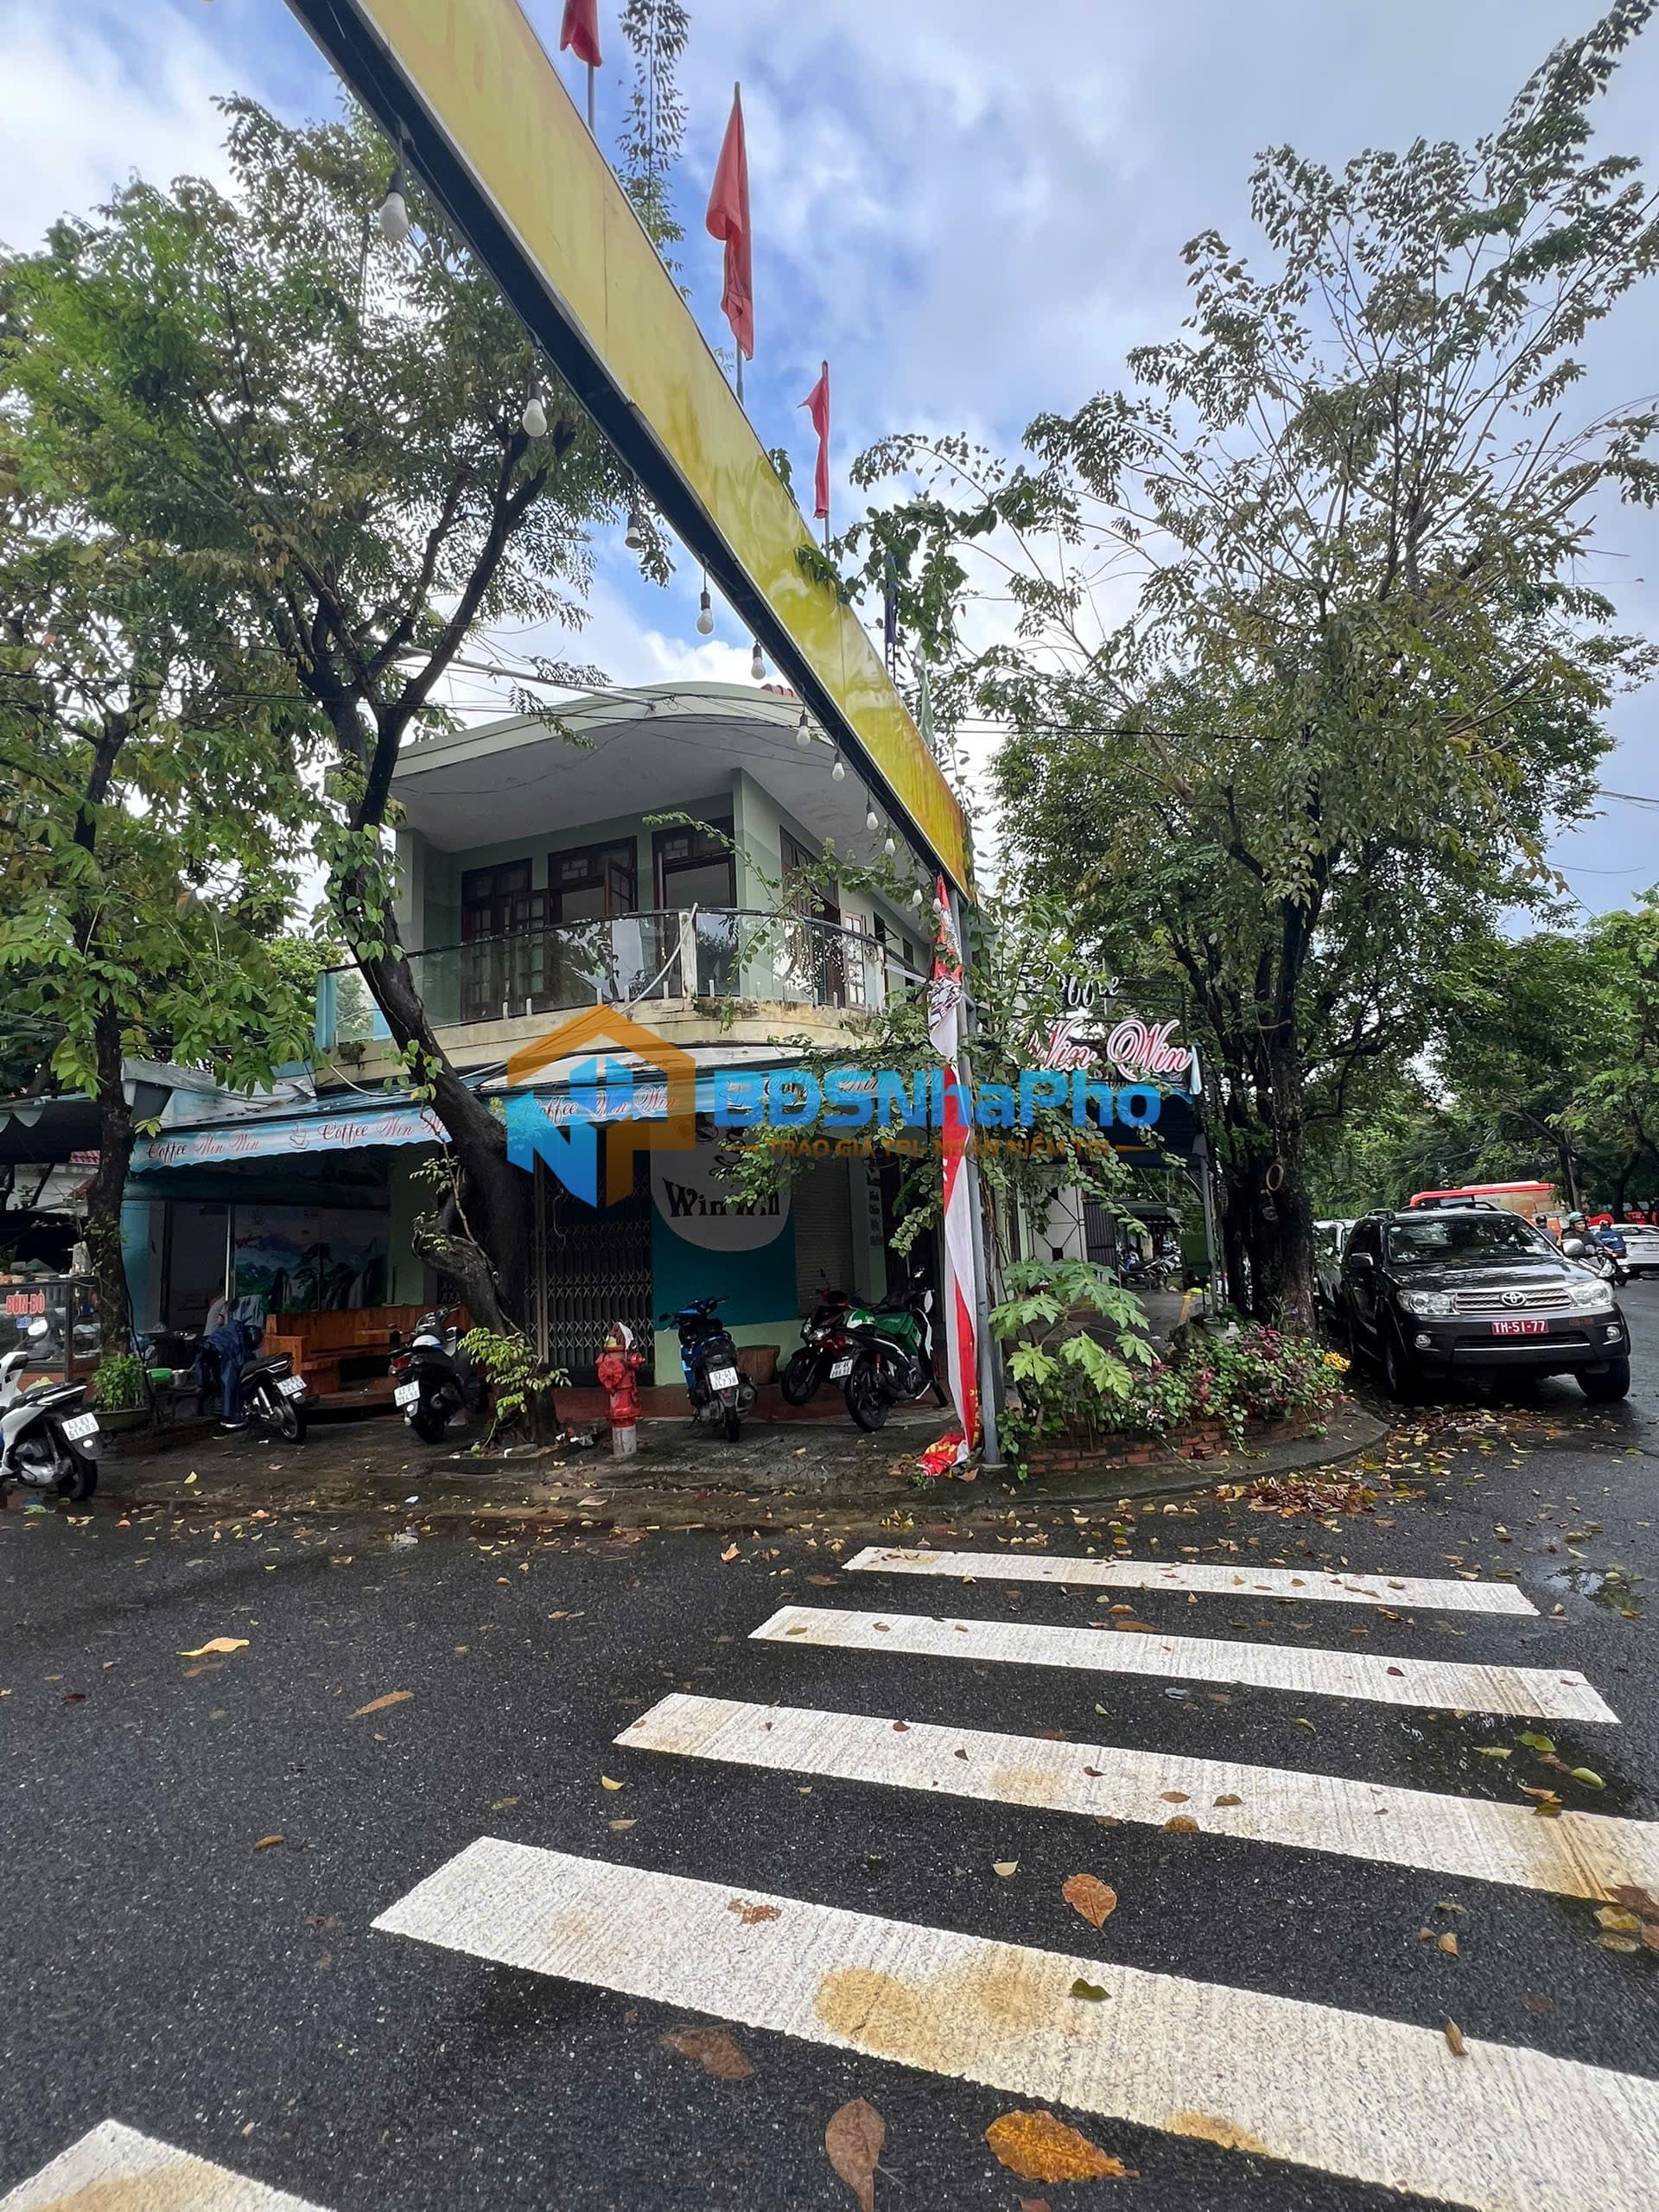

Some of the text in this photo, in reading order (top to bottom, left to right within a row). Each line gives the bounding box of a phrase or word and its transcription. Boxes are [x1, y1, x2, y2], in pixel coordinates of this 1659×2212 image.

[1107, 1019, 1192, 1081] Win
[634, 1084, 677, 1117] Win
[147, 1128, 261, 1164] Coffee Win Win
[317, 1121, 369, 1146] Coffee
[376, 1112, 414, 1141] Win
[662, 1177, 728, 1218] Win
[1492, 1320, 1545, 1333] TH-51-77
